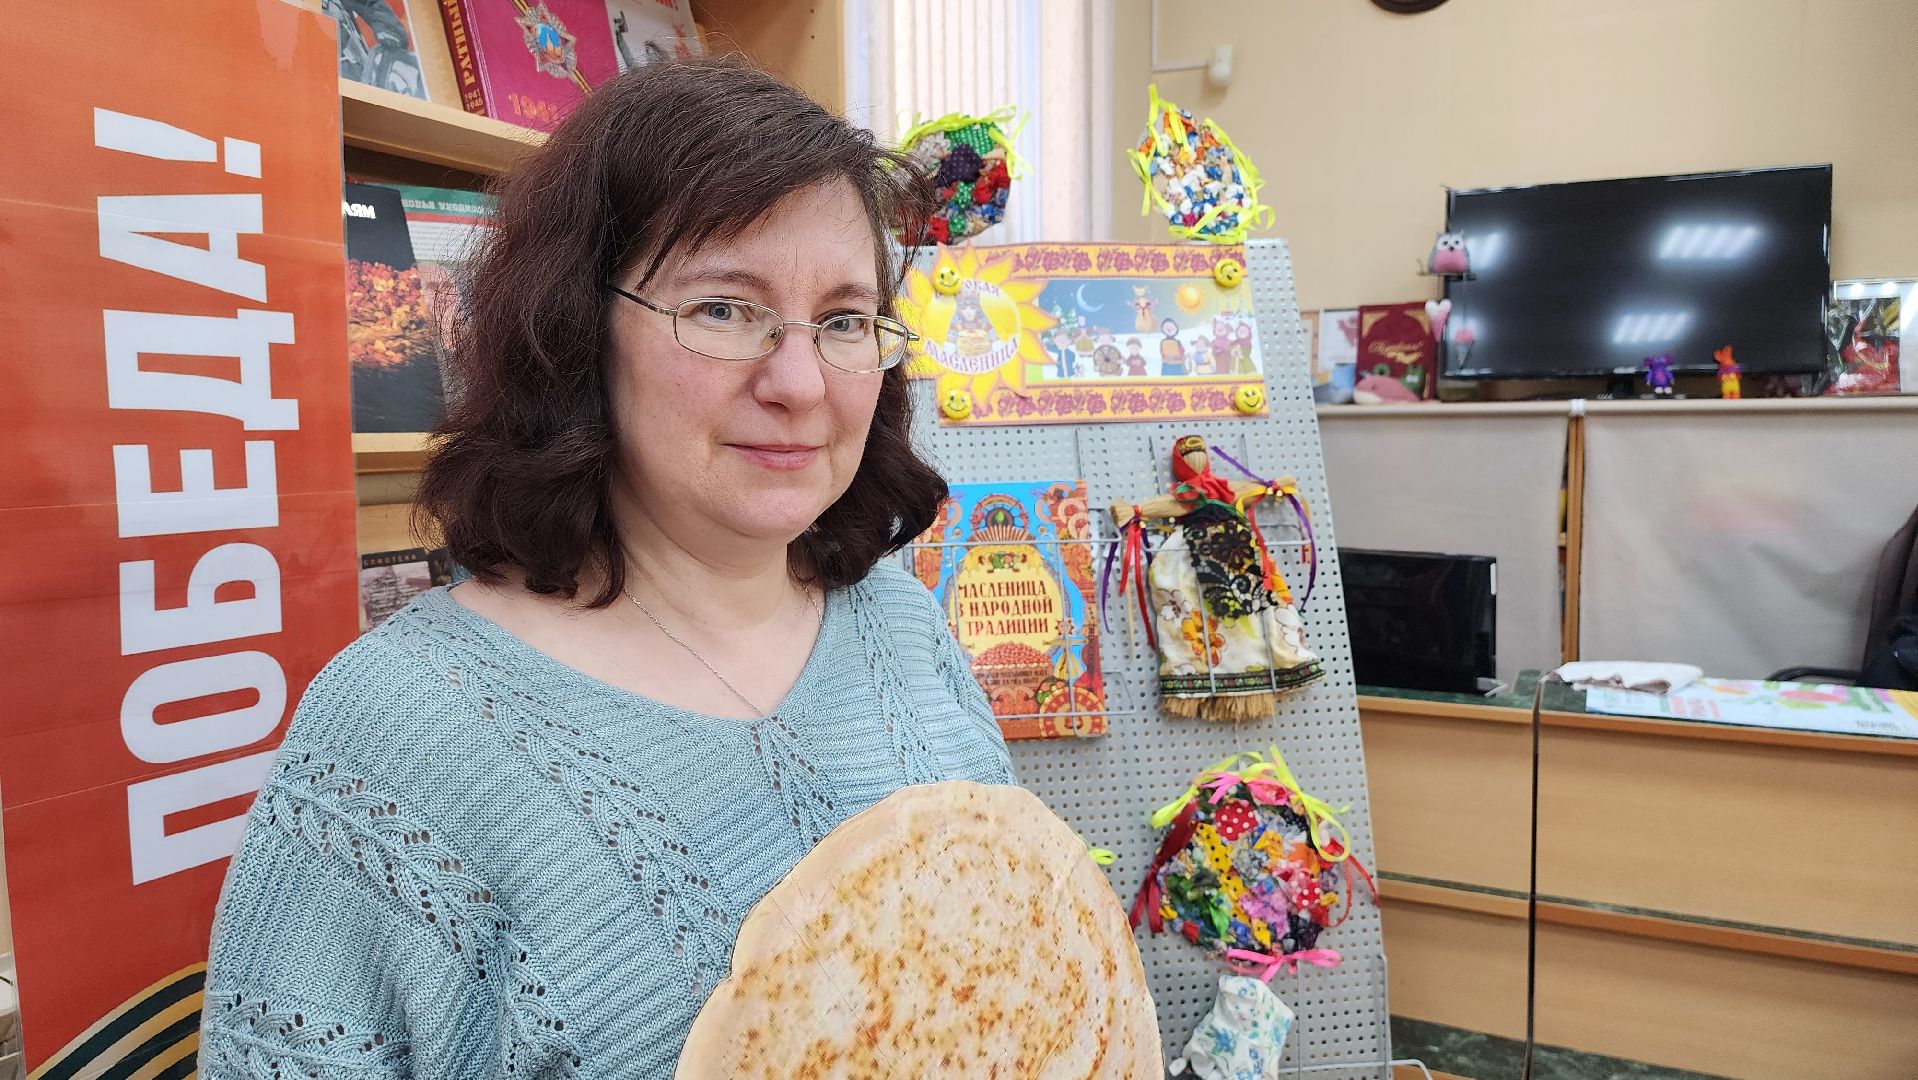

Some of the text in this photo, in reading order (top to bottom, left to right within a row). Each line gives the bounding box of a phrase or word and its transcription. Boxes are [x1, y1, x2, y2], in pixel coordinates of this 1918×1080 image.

[924, 336, 1018, 373] МАСЛЕНИЦА
[94, 106, 299, 885] ПОБЕДА!
[959, 581, 1046, 598] МАСЛЕНИЦА
[969, 596, 1053, 617] НАРОДНОЙ
[967, 618, 1049, 637] ТРАДИЦИИ
